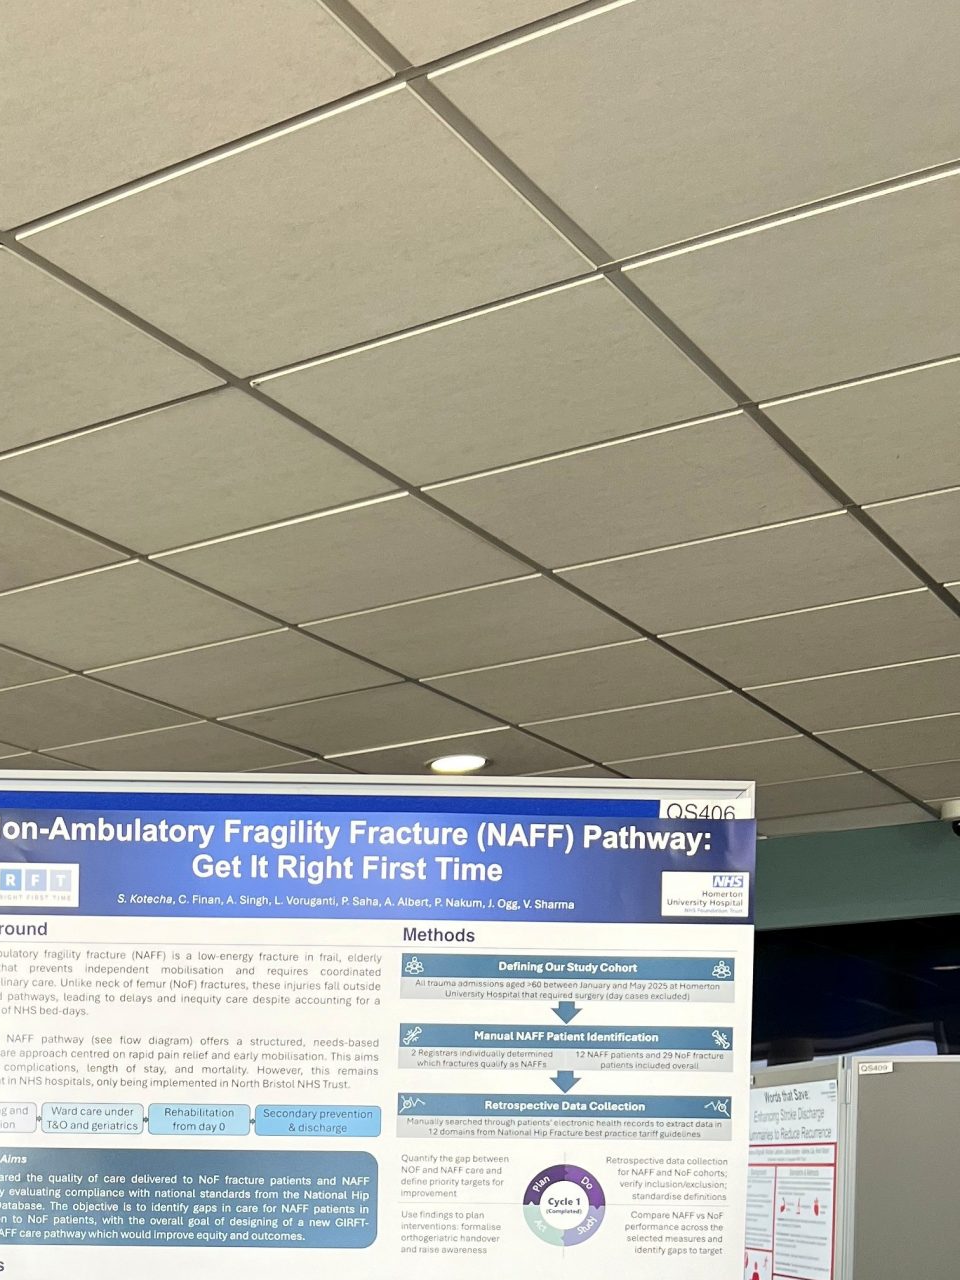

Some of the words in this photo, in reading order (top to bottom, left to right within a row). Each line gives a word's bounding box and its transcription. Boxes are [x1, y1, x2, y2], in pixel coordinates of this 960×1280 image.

[666, 803, 735, 819] QS406
[224, 819, 341, 850] Fragility
[350, 820, 468, 846] Fracture
[477, 822, 574, 855] (NAFF)
[583, 824, 711, 856] Pathway:
[192, 854, 242, 879] Get
[251, 854, 269, 879] It
[277, 854, 354, 884] Right
[362, 855, 427, 880] First
[434, 856, 503, 882] Time
[712, 876, 744, 887] NHS
[701, 890, 743, 898] Homerton
[116, 893, 127, 904] S.
[129, 893, 176, 905] Kotecha,
[178, 894, 190, 905] C.
[192, 894, 224, 906] Finan,
[225, 895, 237, 905] A.
[239, 895, 272, 907] Singh,
[274, 895, 284, 905] L.
[285, 895, 339, 908] Voruganti,
[341, 896, 350, 906] P.
[352, 896, 382, 908] Saha,
[383, 896, 395, 907] A.
[397, 896, 432, 908] Albert,
[434, 897, 443, 907] P.
[445, 897, 486, 909] Nakum,
[487, 898, 495, 909] J.
[497, 898, 521, 911] Ogg,
[522, 898, 533, 909] V.
[534, 899, 575, 910] Sharma
[666, 898, 708, 909] University
[709, 898, 743, 908] Hospital
[403, 927, 475, 943] Methods
[498, 961, 544, 974] Defining
[544, 961, 566, 972] Our
[566, 962, 599, 975] Study
[599, 962, 638, 973] Cohort
[474, 1030, 514, 1041] Manual
[515, 1031, 545, 1041] NAFF
[546, 1031, 585, 1042] Patient
[586, 1031, 659, 1043] Identification
[764, 1092, 781, 1103] Words
[782, 1090, 793, 1101] that
[9, 1106, 29, 1116] and
[51, 1106, 78, 1116] Ward
[79, 1108, 103, 1116] care
[104, 1107, 134, 1117] under
[164, 1107, 235, 1118] Rehabilitation
[484, 1100, 560, 1113] Retrospective
[561, 1101, 588, 1111] Data
[588, 1101, 646, 1112] Collection
[263, 1108, 318, 1121] Secondary
[319, 1110, 373, 1121] prevention
[46, 1121, 68, 1129] T&O
[70, 1122, 90, 1130] and
[93, 1121, 139, 1132] geriatrics
[172, 1121, 197, 1131] from
[198, 1122, 218, 1133] day
[218, 1122, 226, 1132] 0
[288, 1123, 295, 1132] &
[298, 1122, 348, 1135] discharge
[749, 1131, 773, 1141] ummaries
[0, 1154, 27, 1164] Aims
[533, 1176, 550, 1192] Plan
[581, 1176, 592, 1189] Do
[547, 1197, 574, 1208] Cycle
[575, 1197, 581, 1206] 1
[577, 1216, 597, 1235] Study
